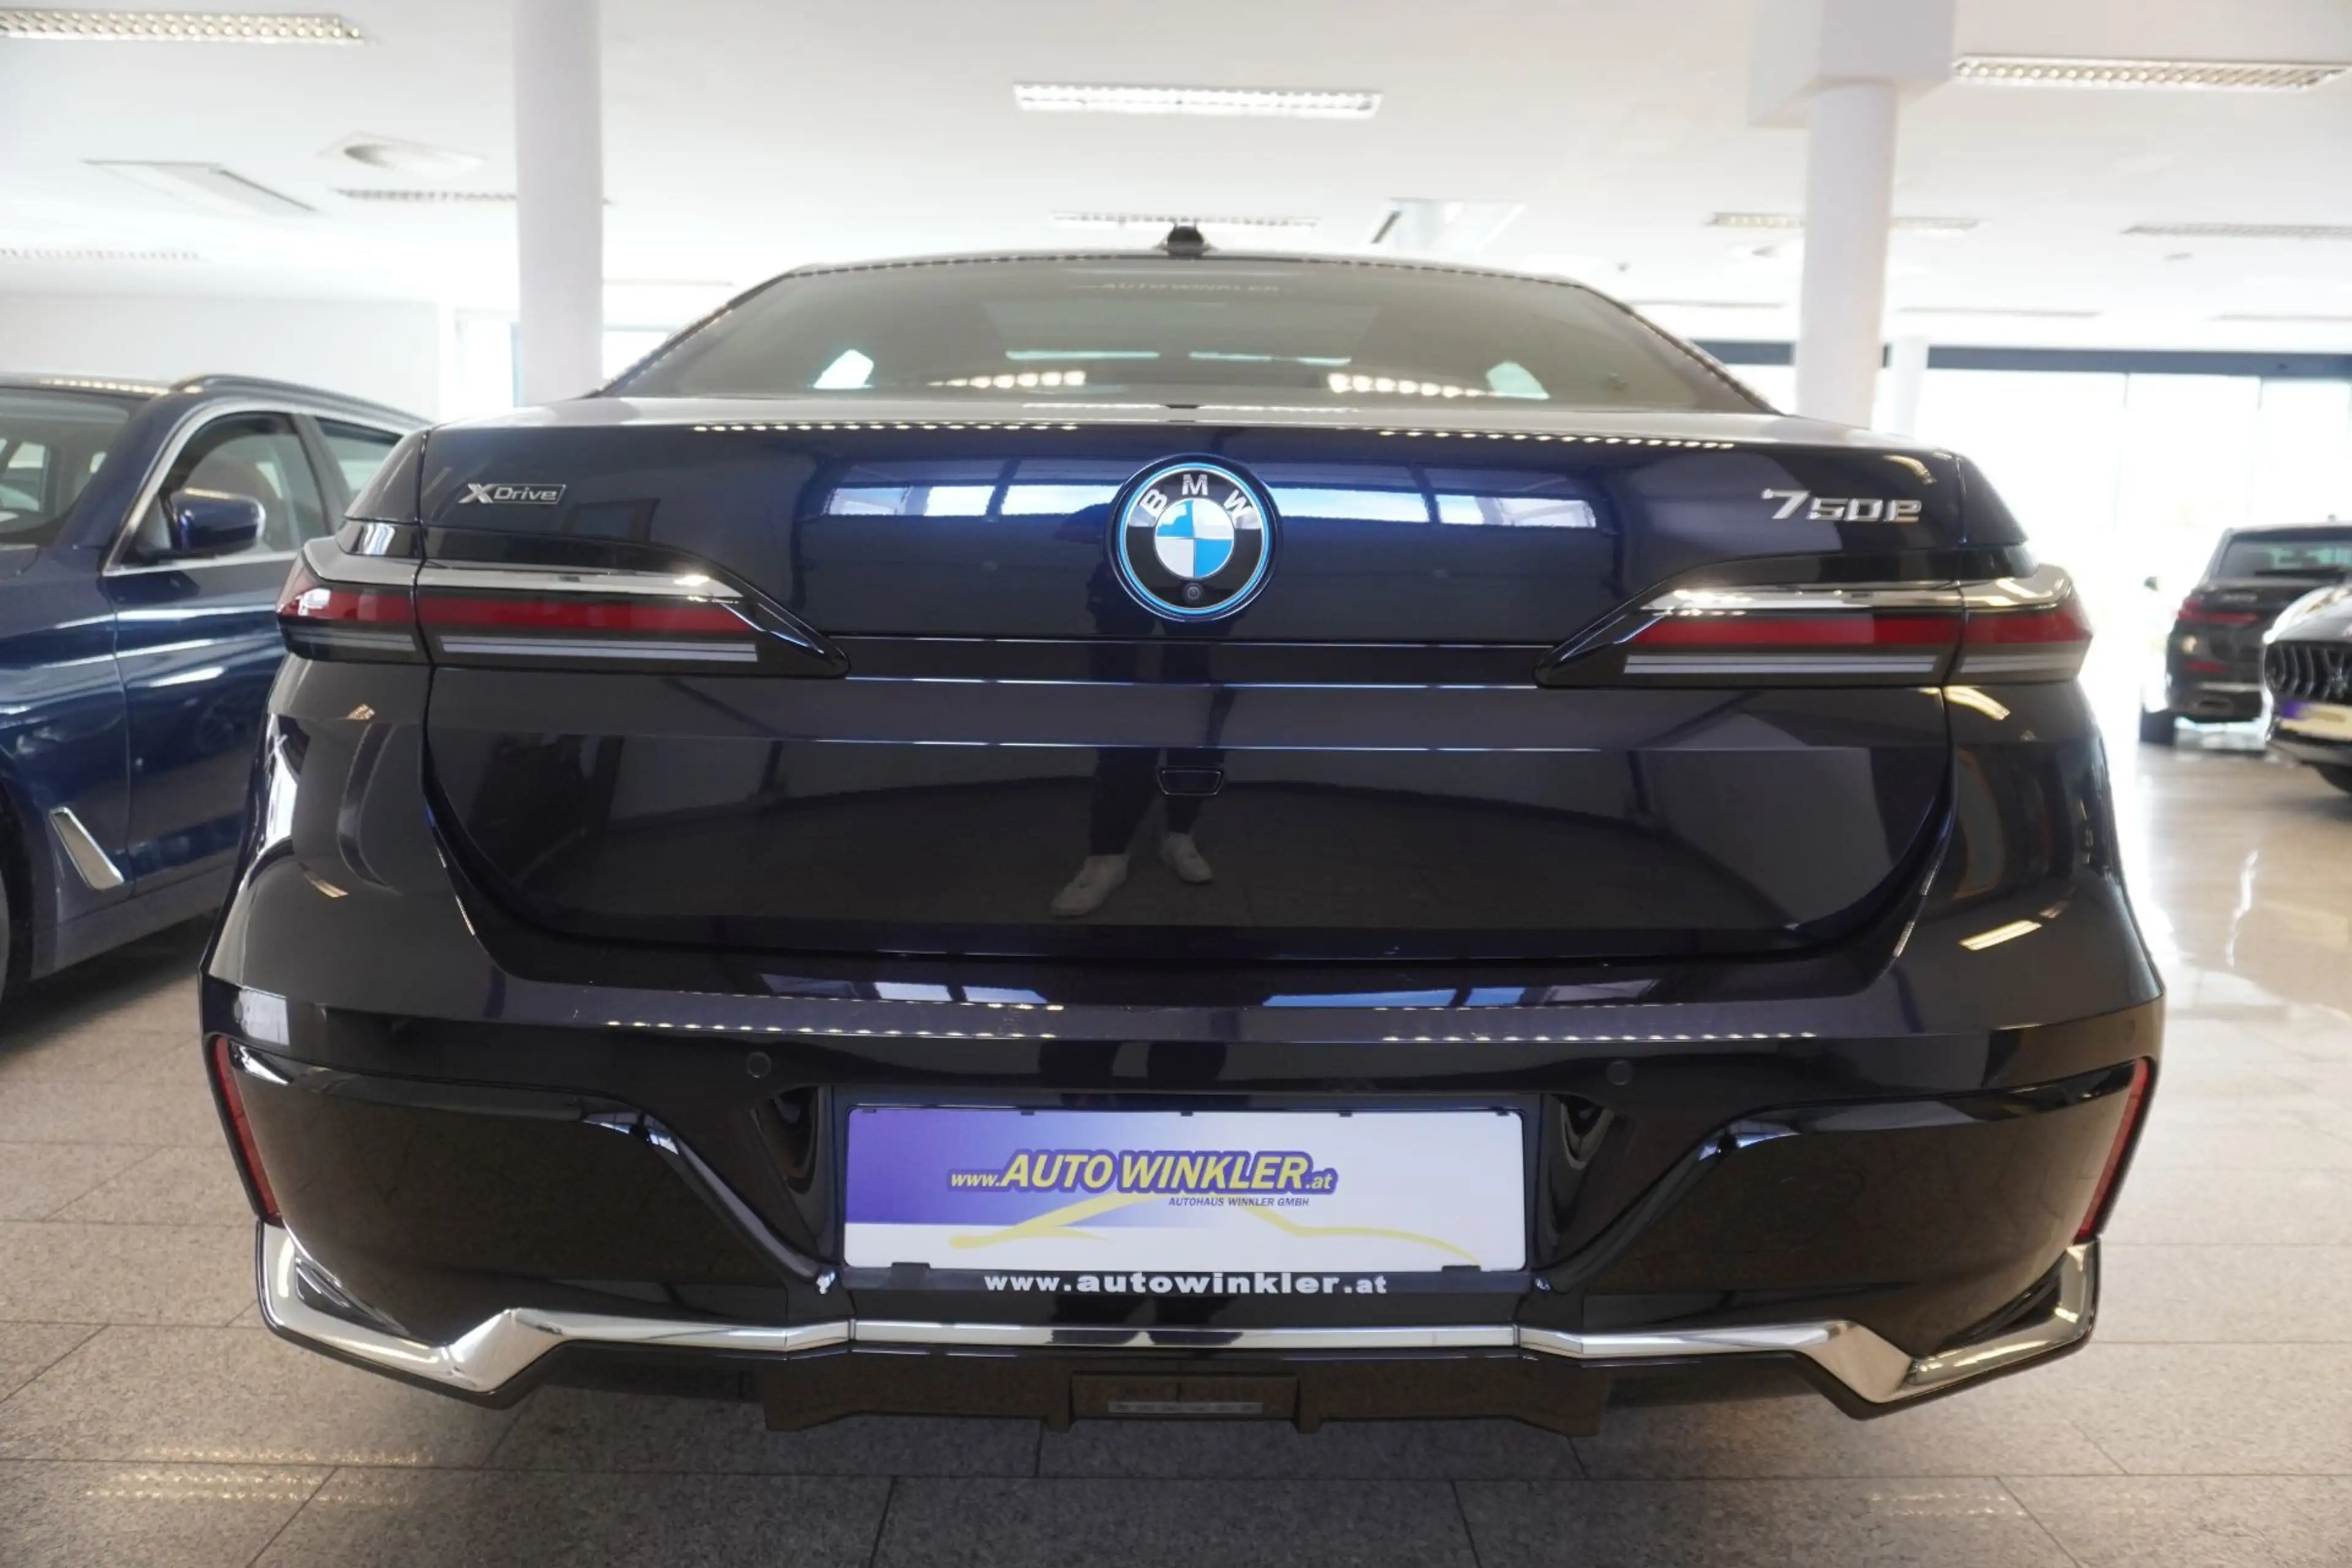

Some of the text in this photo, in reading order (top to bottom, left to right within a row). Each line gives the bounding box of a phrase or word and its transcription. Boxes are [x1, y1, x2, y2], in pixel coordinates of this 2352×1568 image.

[1139, 473, 1254, 518] BMW
[1169, 1197, 1309, 1207] AUTOHAUS WINKLER GMBH
[983, 1272, 1387, 1294] www.autowinkler.at
